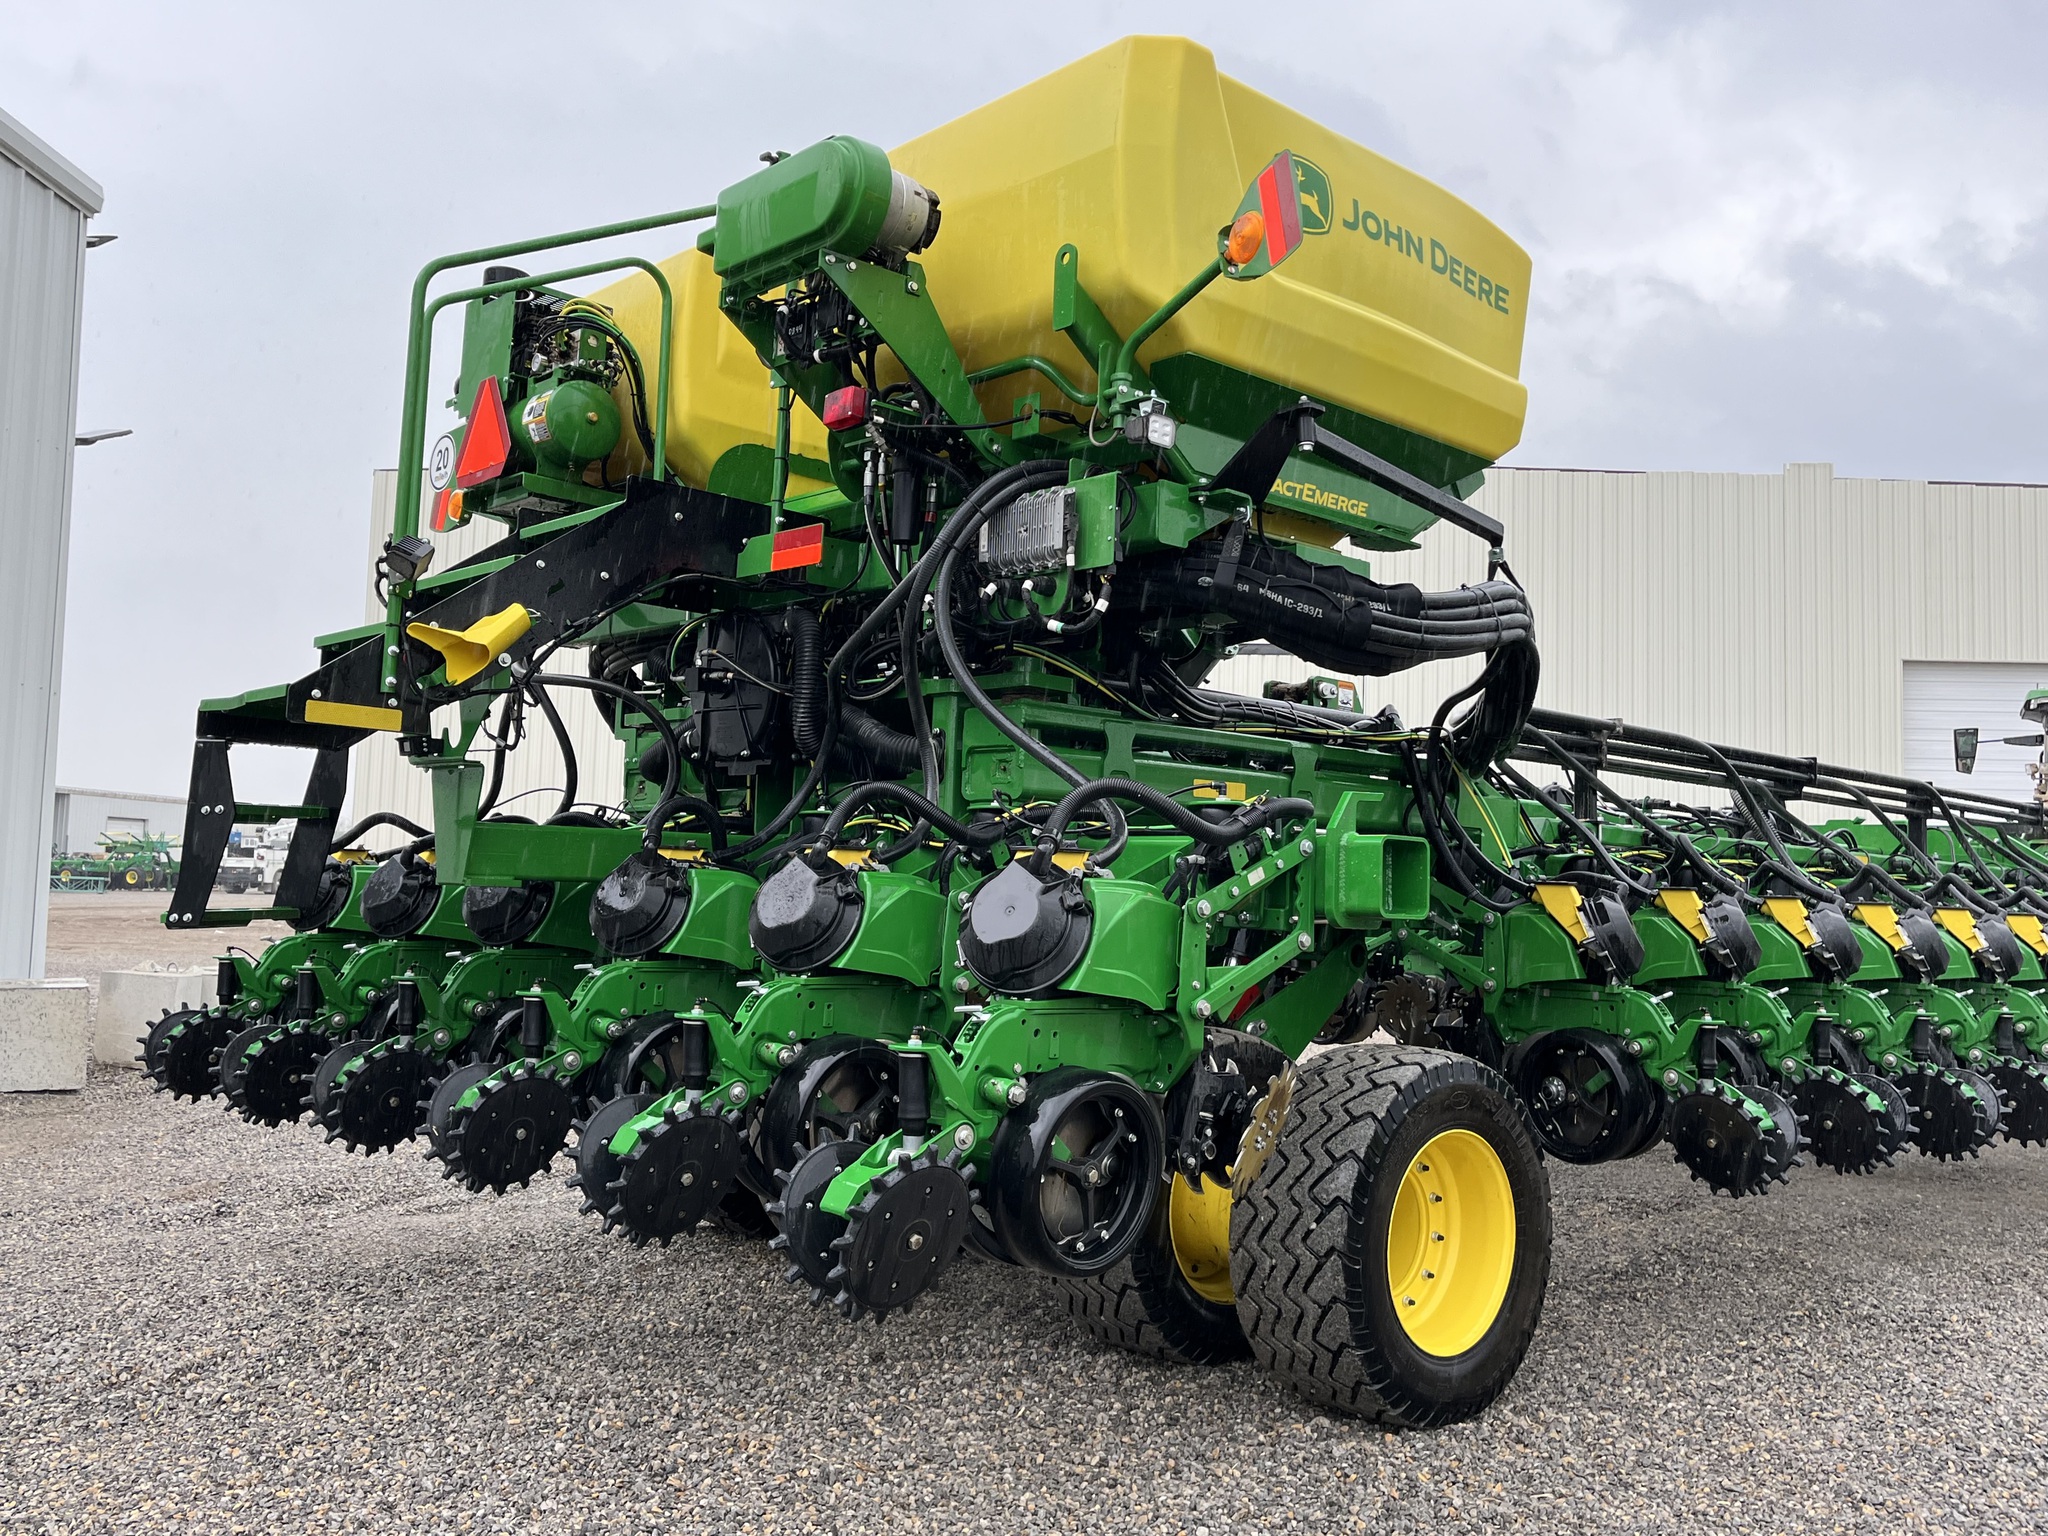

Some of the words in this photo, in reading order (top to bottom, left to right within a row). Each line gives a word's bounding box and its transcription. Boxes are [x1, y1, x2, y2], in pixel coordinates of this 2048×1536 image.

[1343, 198, 1424, 264] JOHN
[1430, 238, 1509, 315] DEERE
[436, 446, 449, 472] 20
[1270, 479, 1369, 517] ACTEMERGE
[1284, 597, 1323, 618] IC-293/1
